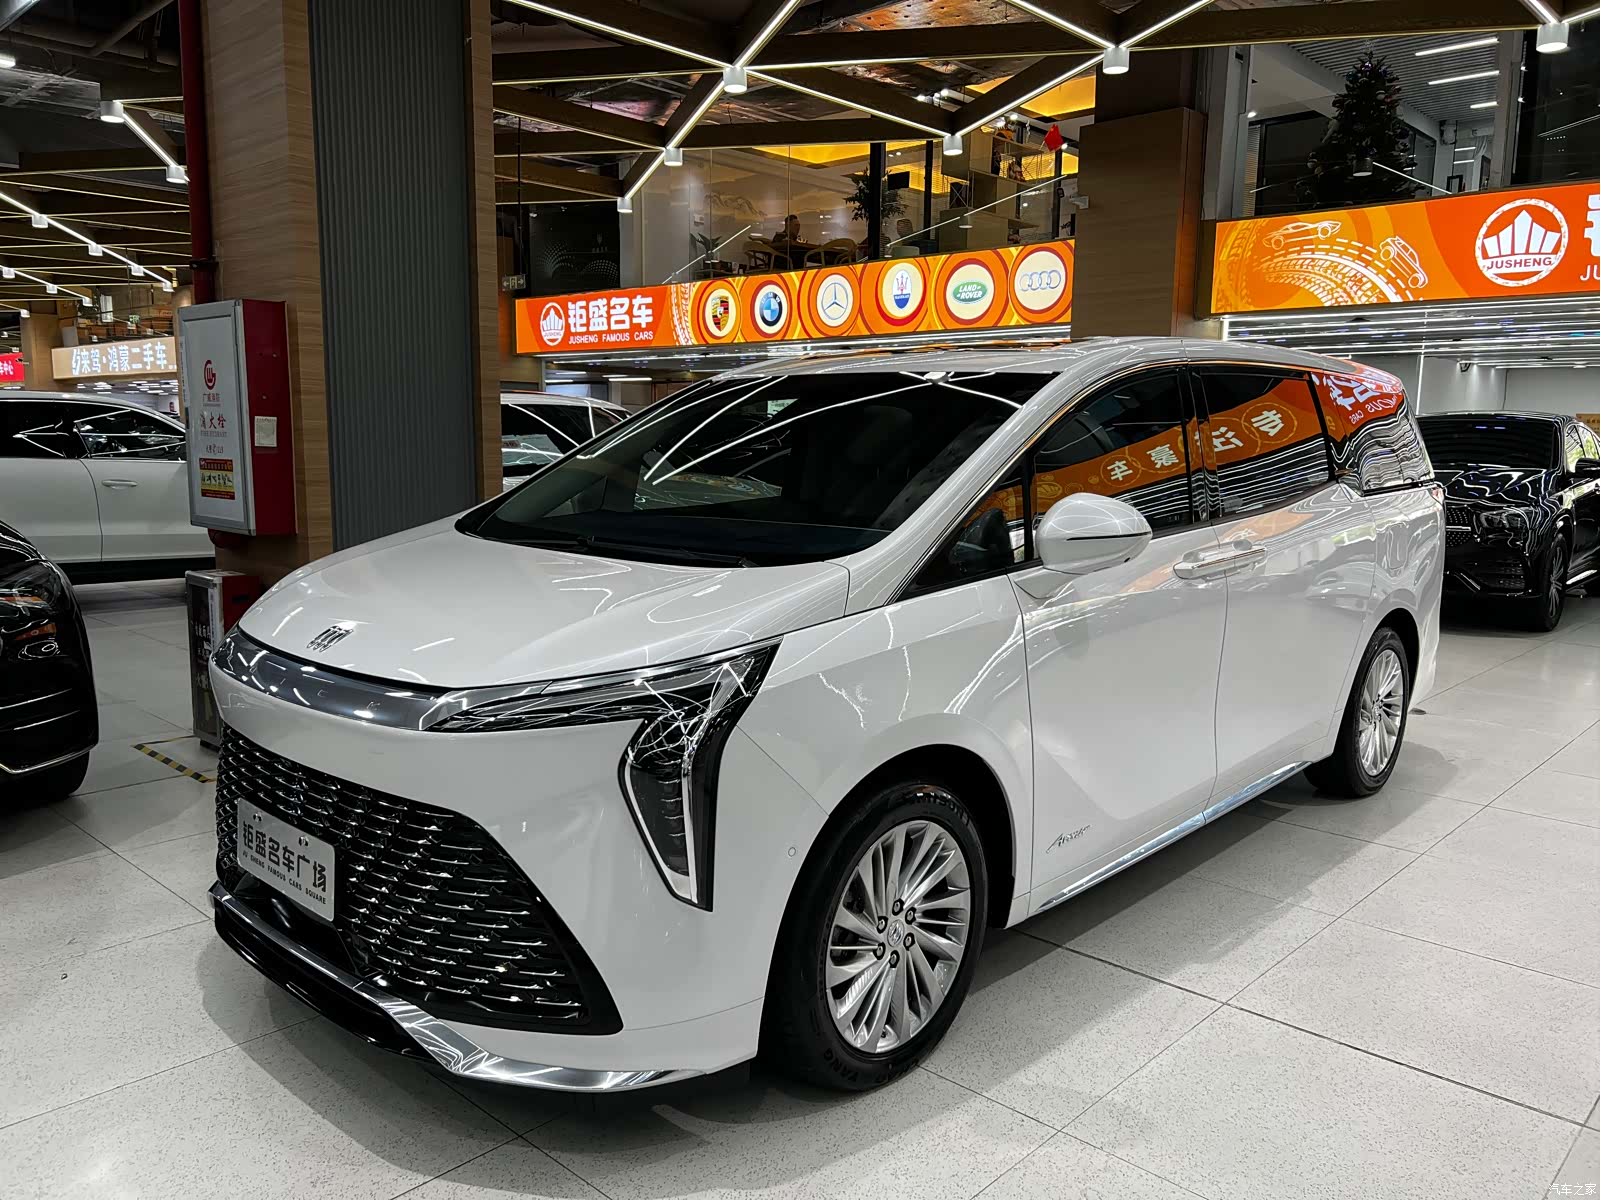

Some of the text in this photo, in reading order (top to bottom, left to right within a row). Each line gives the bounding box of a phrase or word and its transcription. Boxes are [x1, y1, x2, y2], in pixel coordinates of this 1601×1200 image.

[1487, 256, 1552, 270] JUSHENG
[959, 284, 977, 293] LAND
[960, 292, 983, 300] ROVER
[567, 295, 653, 332] 钜盛名车
[568, 331, 654, 344] JUSHENG FAMOUS CARS
[242, 820, 327, 893] 钜盛名车广场
[267, 865, 286, 882] FAMOUS
[288, 877, 302, 891] CARS
[305, 887, 327, 905] SQUARE
